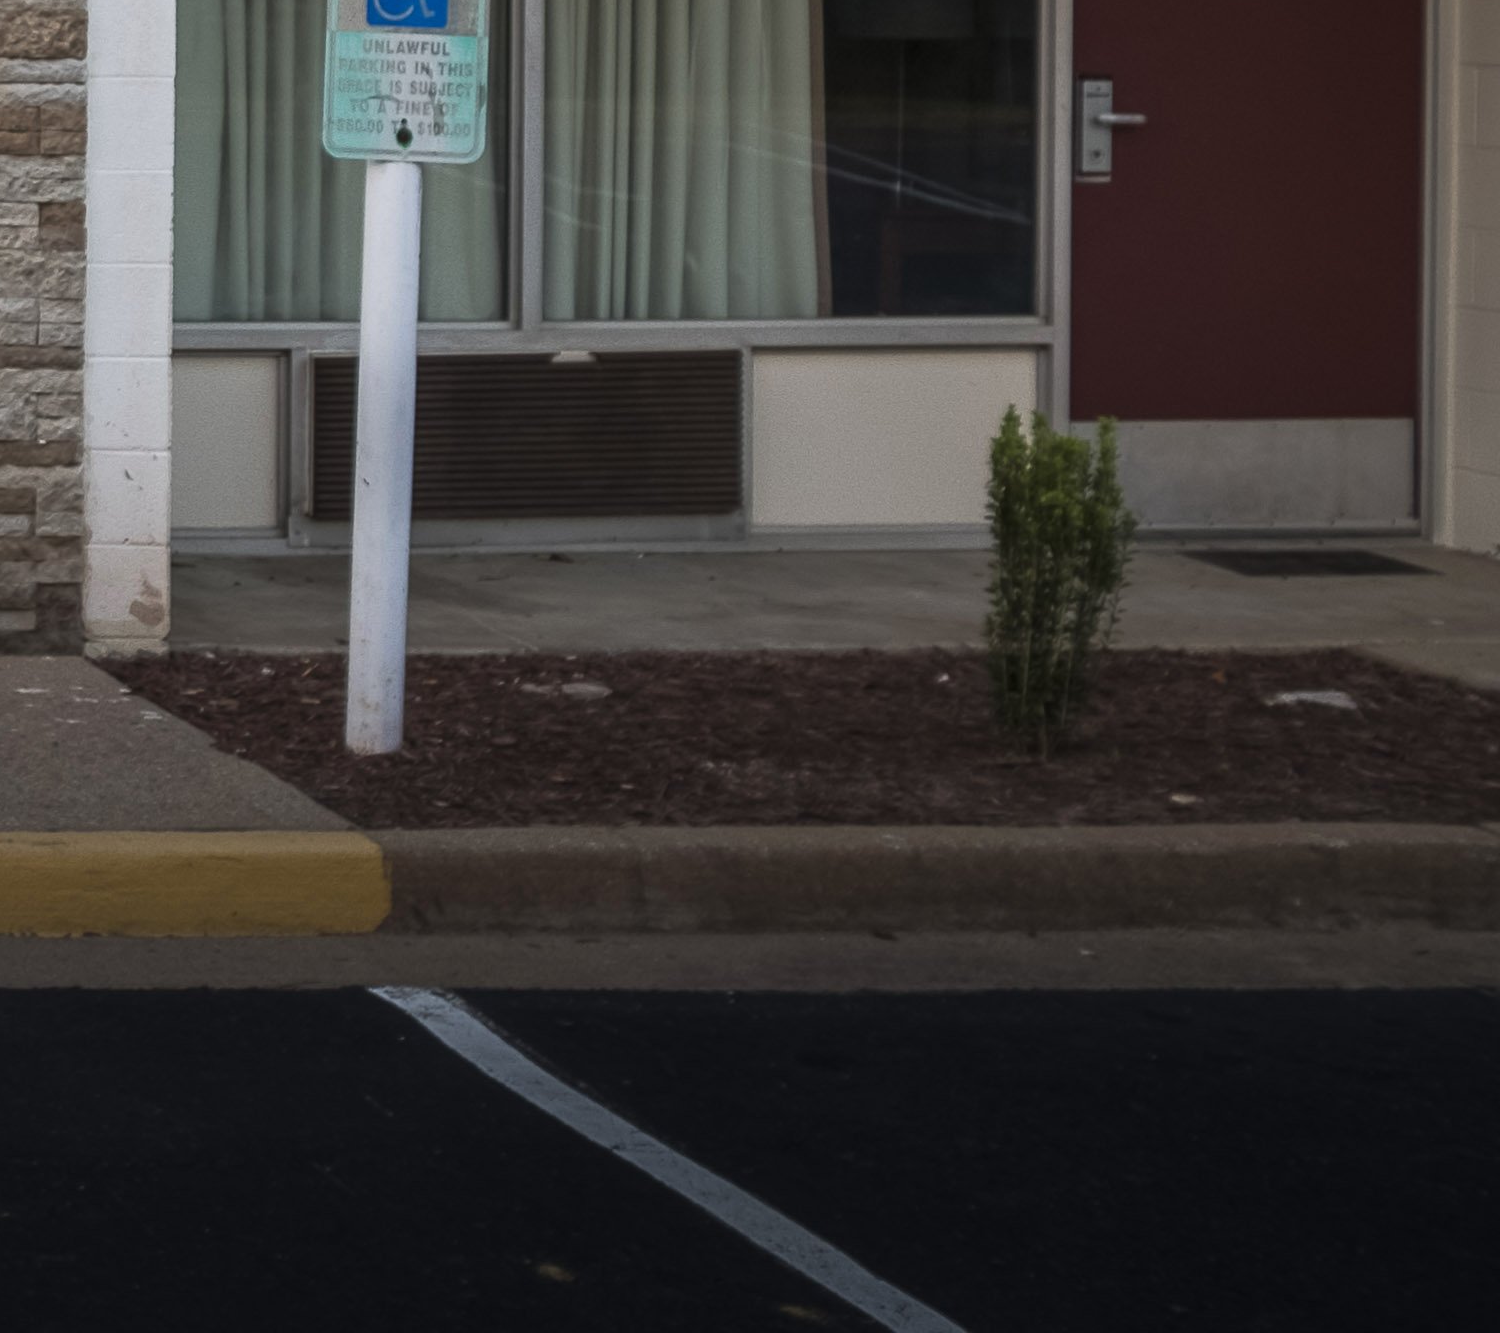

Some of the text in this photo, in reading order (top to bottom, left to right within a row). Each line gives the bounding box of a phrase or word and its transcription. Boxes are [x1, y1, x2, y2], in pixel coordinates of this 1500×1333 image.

[362, 39, 450, 56] UNLAWFUL
[338, 58, 473, 77] PARKING IN THIS
[390, 80, 402, 94] IS
[410, 81, 472, 98] SUBJECT
[395, 100, 432, 116] FINE
